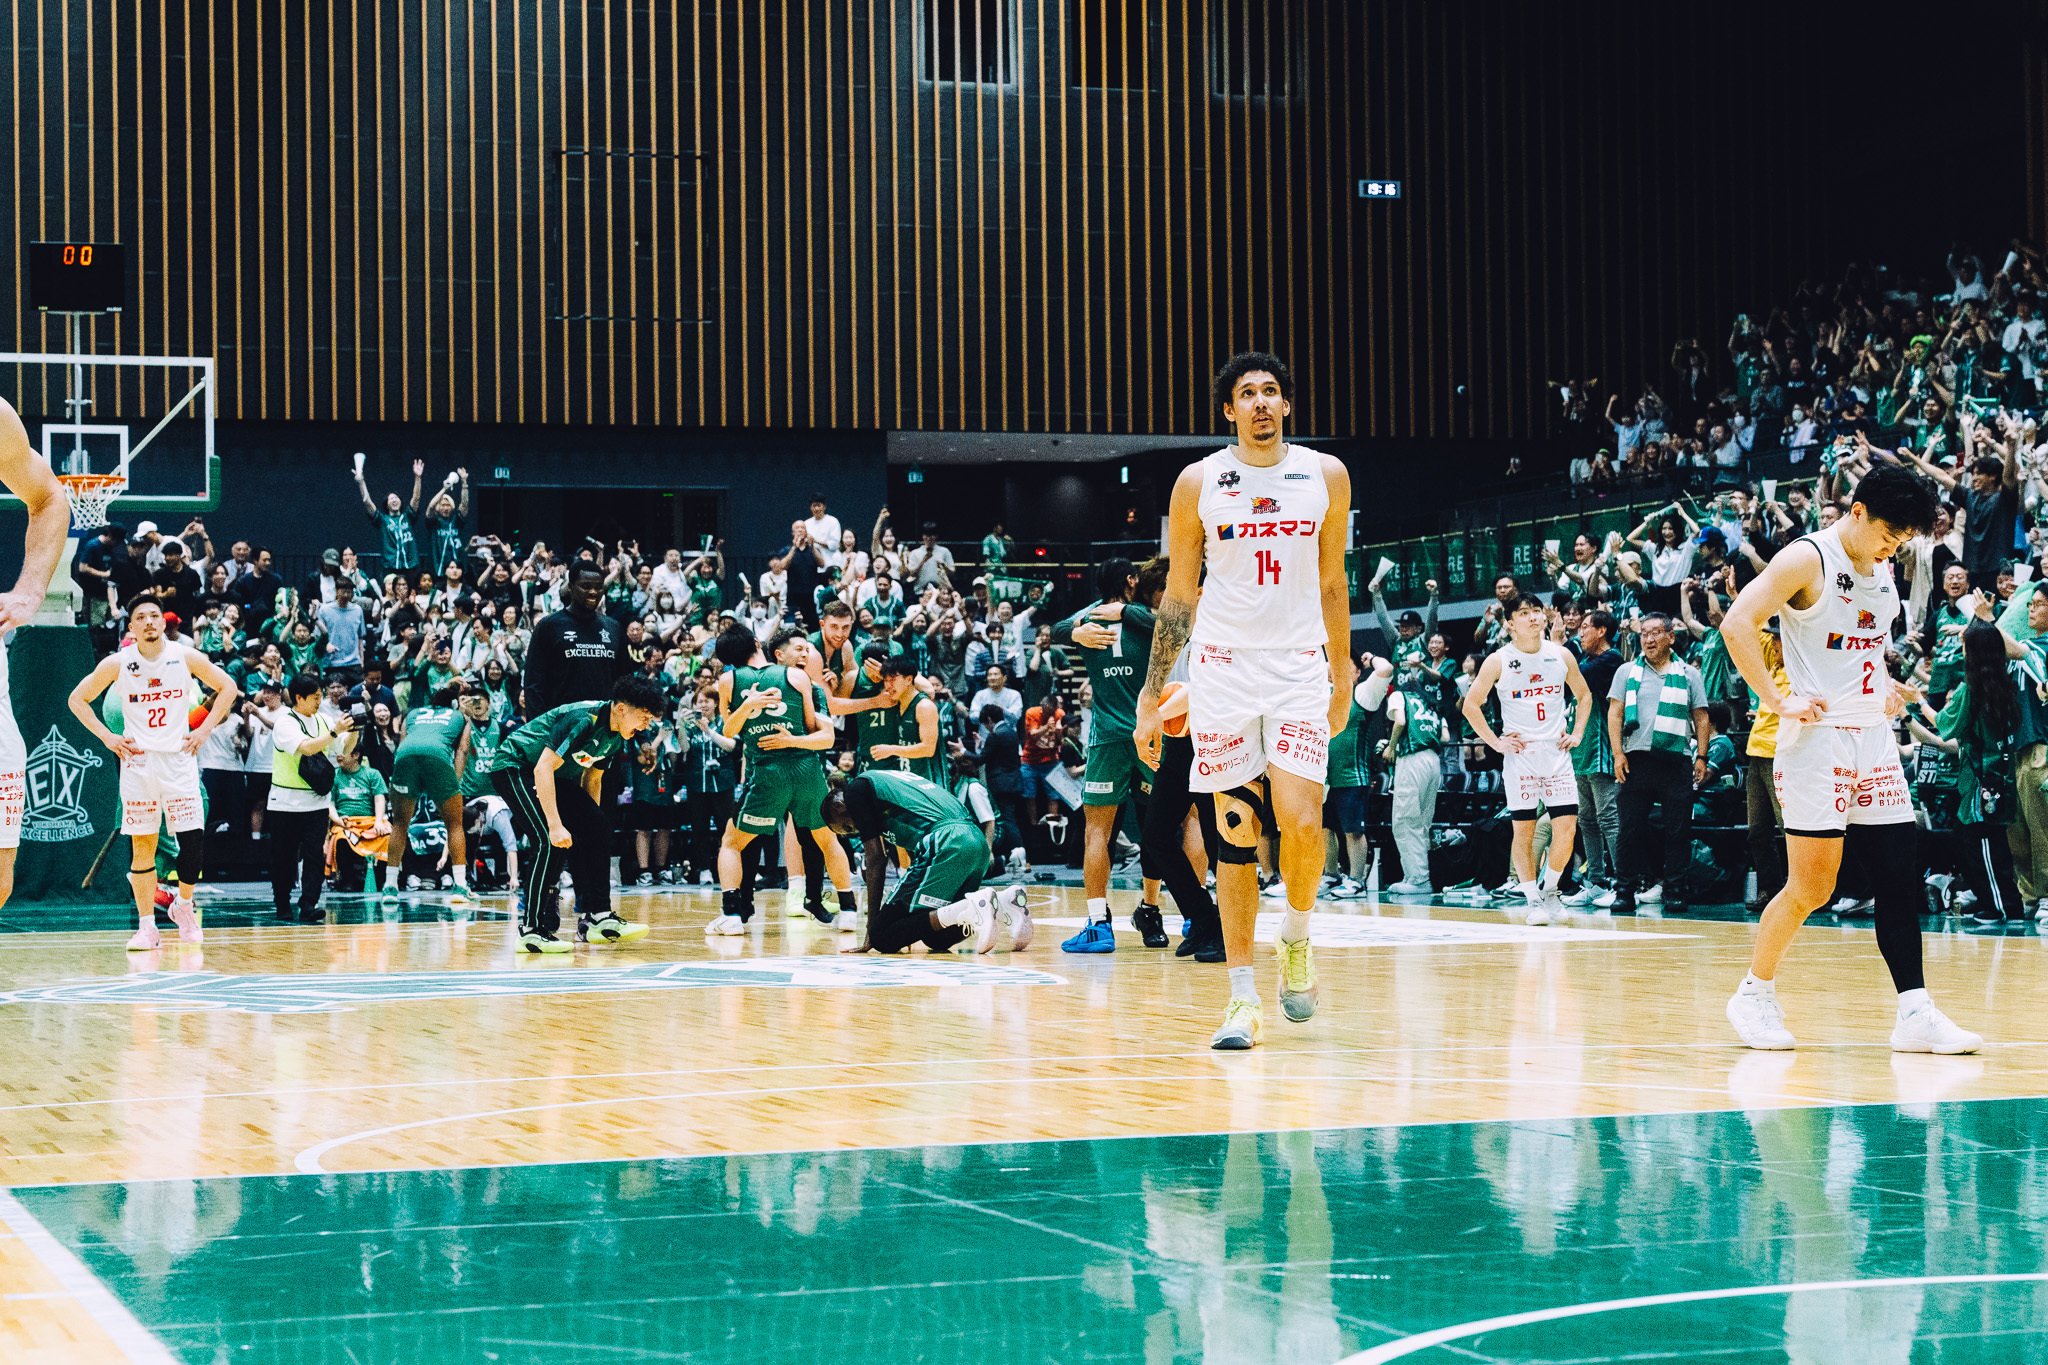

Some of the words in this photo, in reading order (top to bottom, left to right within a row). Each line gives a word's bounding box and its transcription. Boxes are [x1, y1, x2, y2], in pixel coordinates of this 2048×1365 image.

[1238, 520, 1316, 538] カネマン
[1254, 549, 1282, 586] 14
[1103, 666, 1134, 678] BOYD
[1862, 660, 1876, 695] 2
[140, 689, 184, 703] カネマン
[1523, 685, 1562, 698] カネマン
[148, 707, 167, 728] 22
[869, 710, 886, 728] 21
[1536, 702, 1546, 722] 6
[20, 821, 95, 842] XCELLENCE
